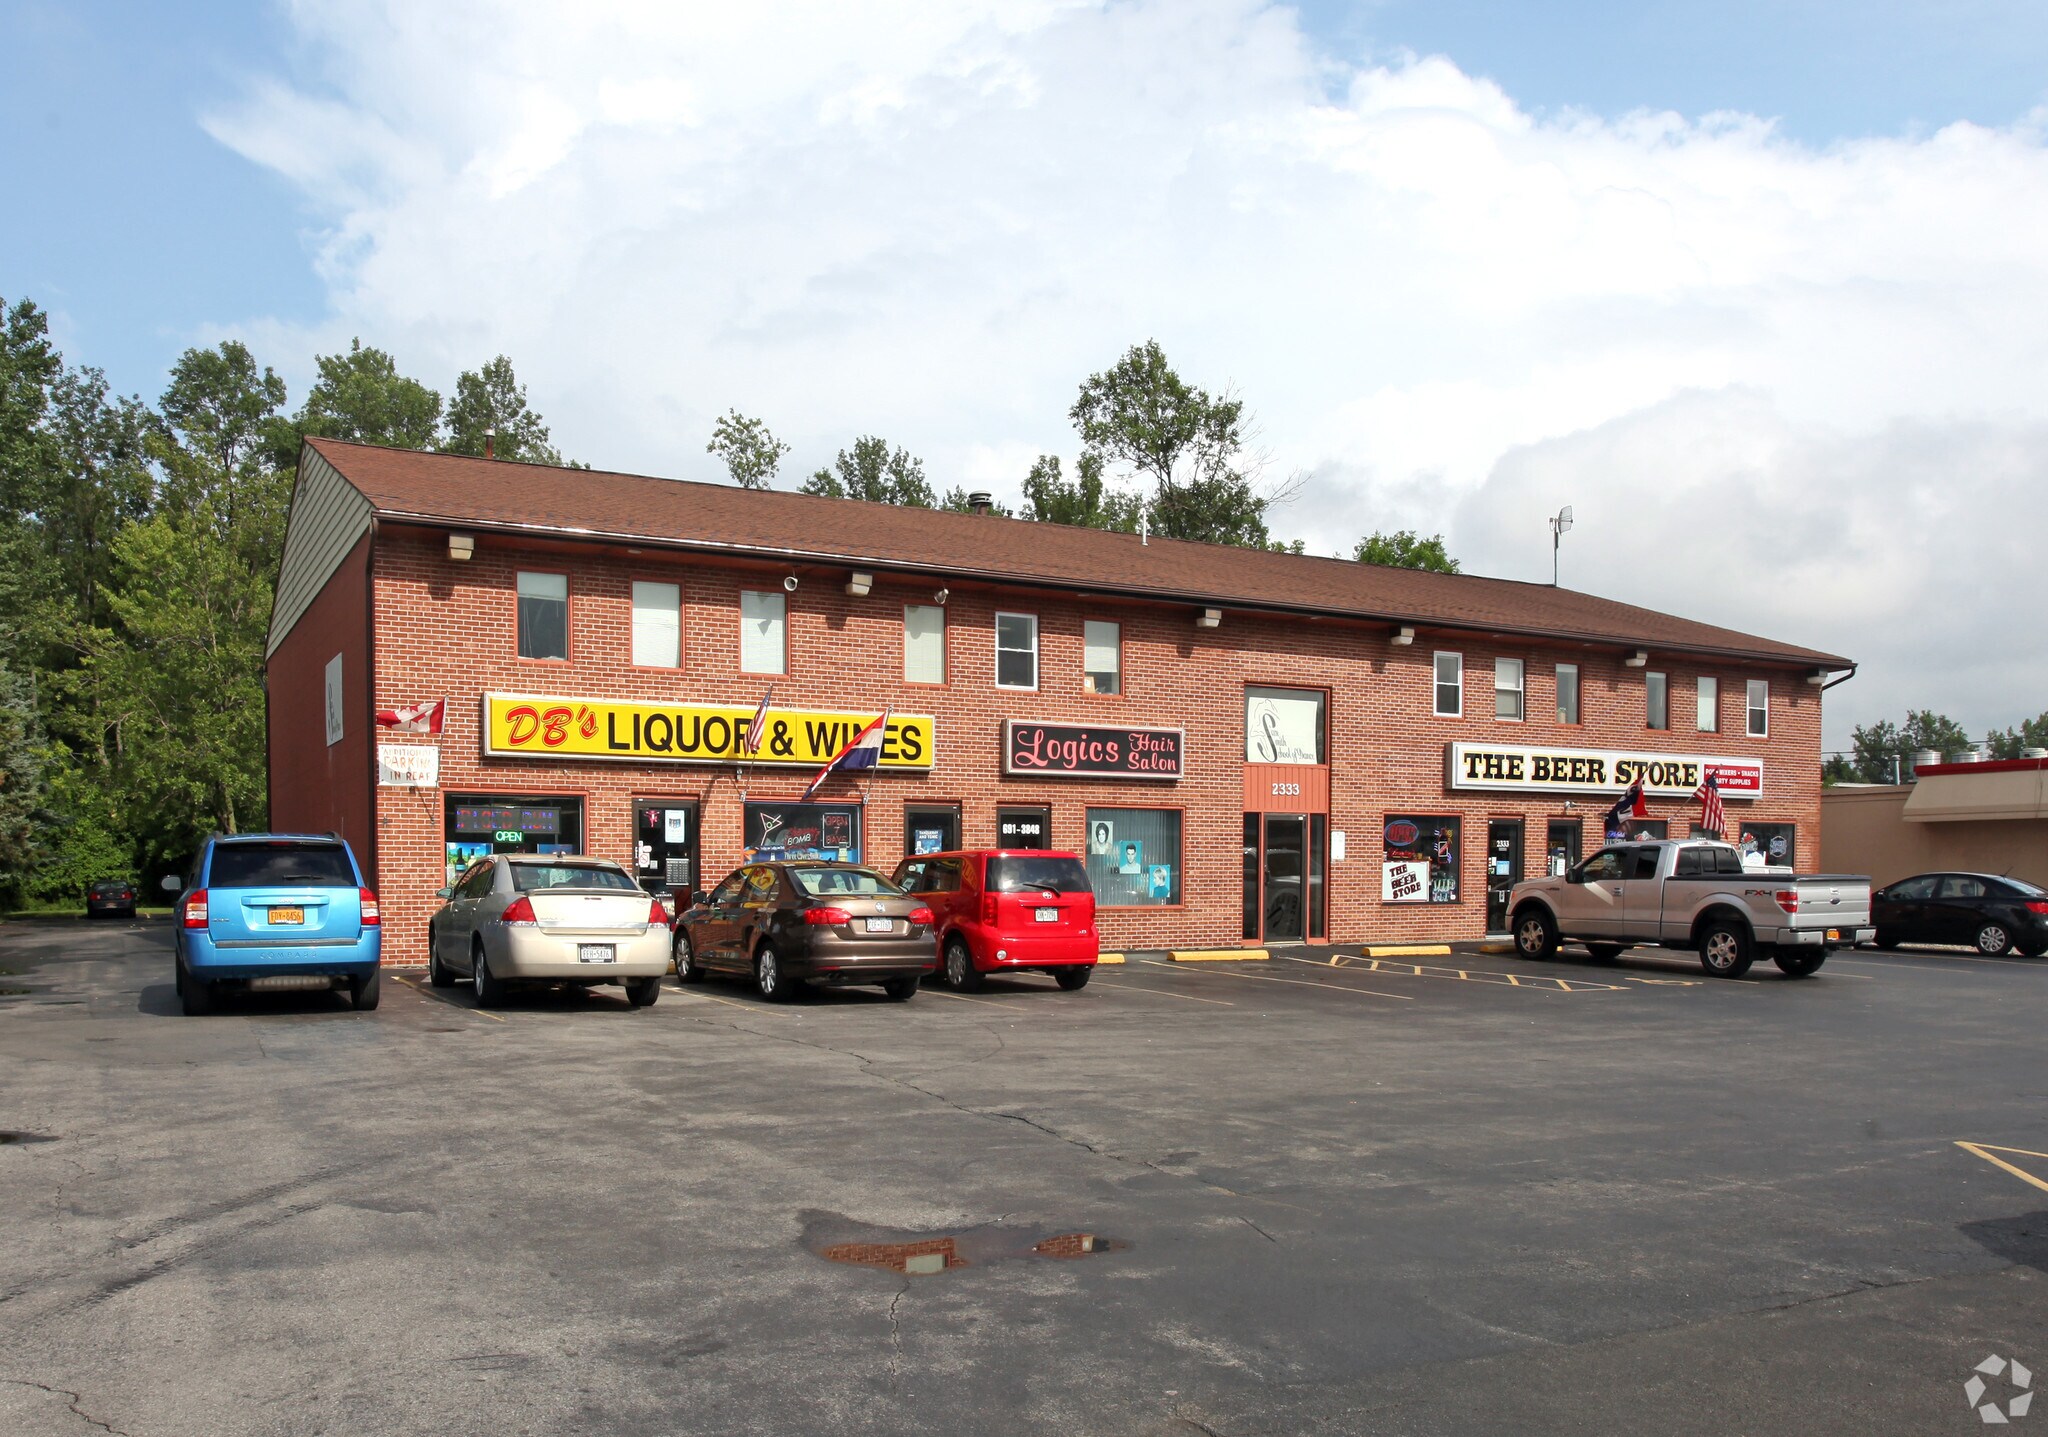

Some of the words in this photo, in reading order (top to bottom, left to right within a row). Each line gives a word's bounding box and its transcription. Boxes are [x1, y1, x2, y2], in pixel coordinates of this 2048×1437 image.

[505, 704, 599, 747] DB's
[770, 720, 795, 756] &
[1015, 729, 1119, 769] Logics
[1128, 733, 1176, 752] Hair
[1127, 751, 1177, 771] Salon
[390, 770, 400, 781] IN
[1464, 753, 1524, 780] THE
[1531, 756, 1606, 783] BEER
[1615, 760, 1697, 787] STORE
[1272, 783, 1300, 795] 2333
[825, 815, 848, 826] OPEN
[495, 830, 522, 842] OPEN
[787, 833, 811, 846] BOMB
[1496, 840, 1510, 848] 2333
[1389, 864, 1408, 878] THE
[1391, 871, 1417, 890] BEER
[1392, 881, 1422, 900] STORE
